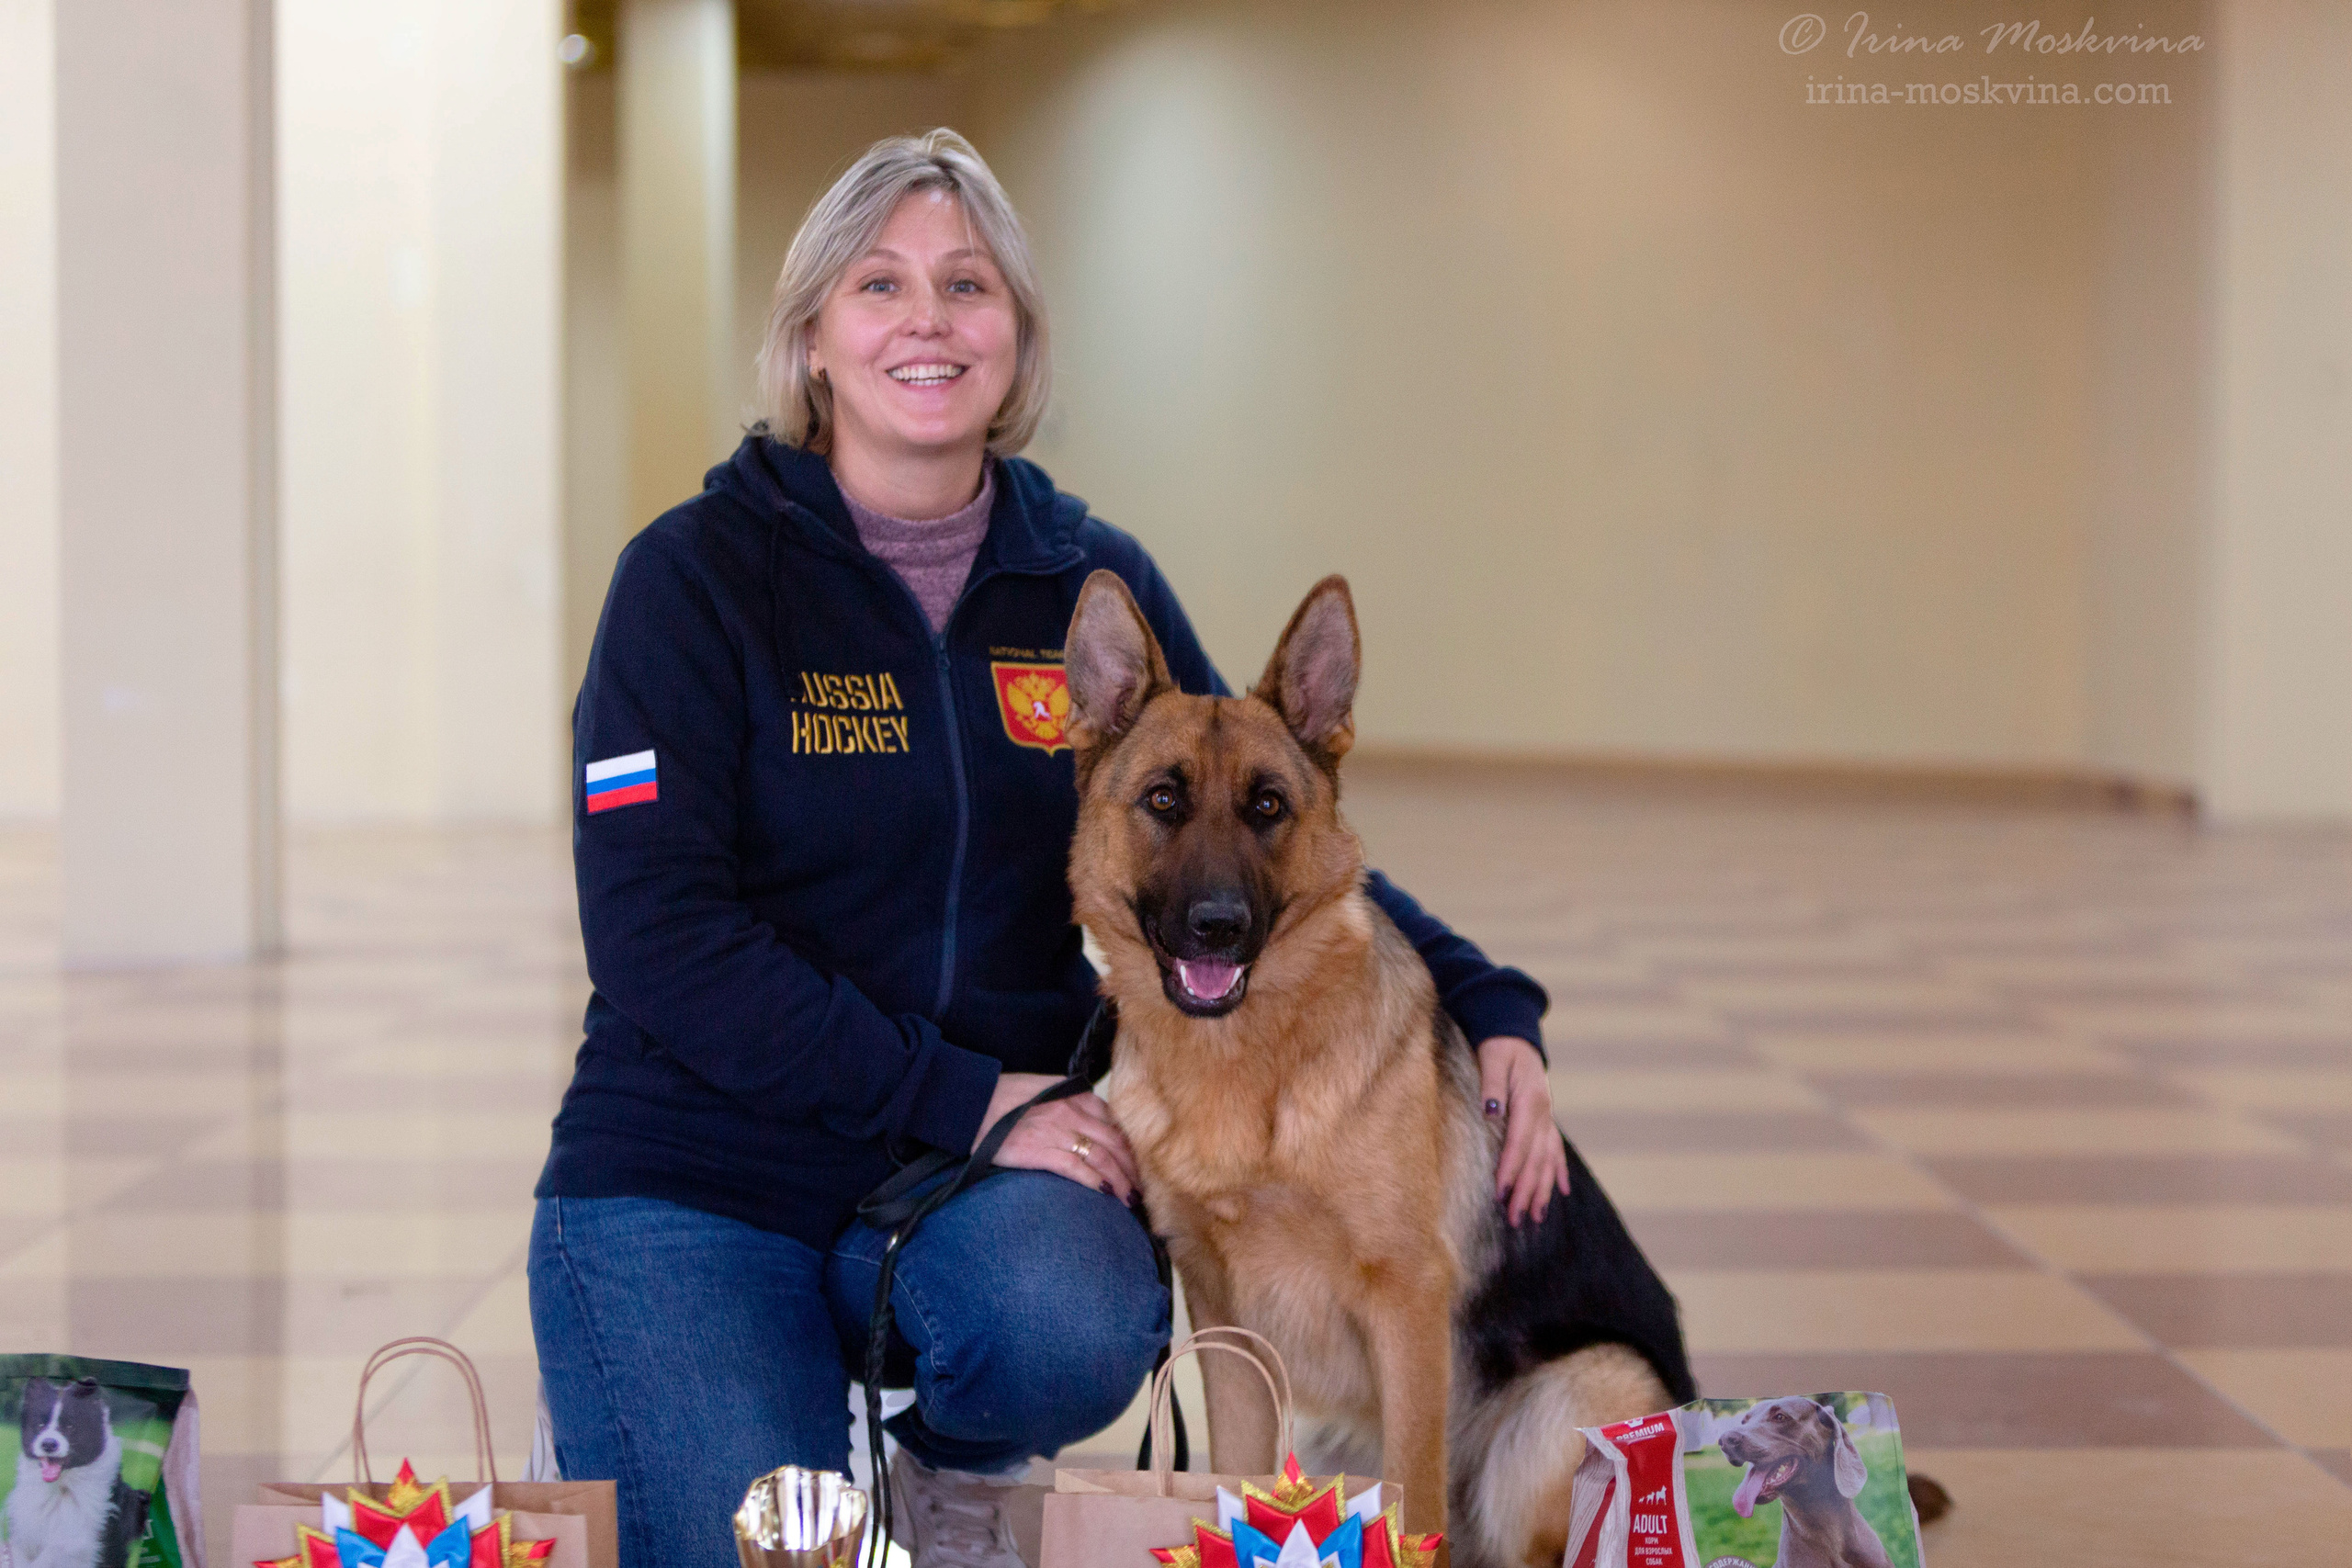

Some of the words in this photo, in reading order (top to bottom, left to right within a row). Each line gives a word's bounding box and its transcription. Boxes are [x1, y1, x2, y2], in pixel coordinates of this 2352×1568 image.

[791, 671, 904, 710] USSIA
[792, 711, 910, 754] HOCKEY
[1633, 1514, 1668, 1534] ADULT
[1645, 1537, 1658, 1545] КОРМ
[1645, 1557, 1663, 1565] СОБАК
